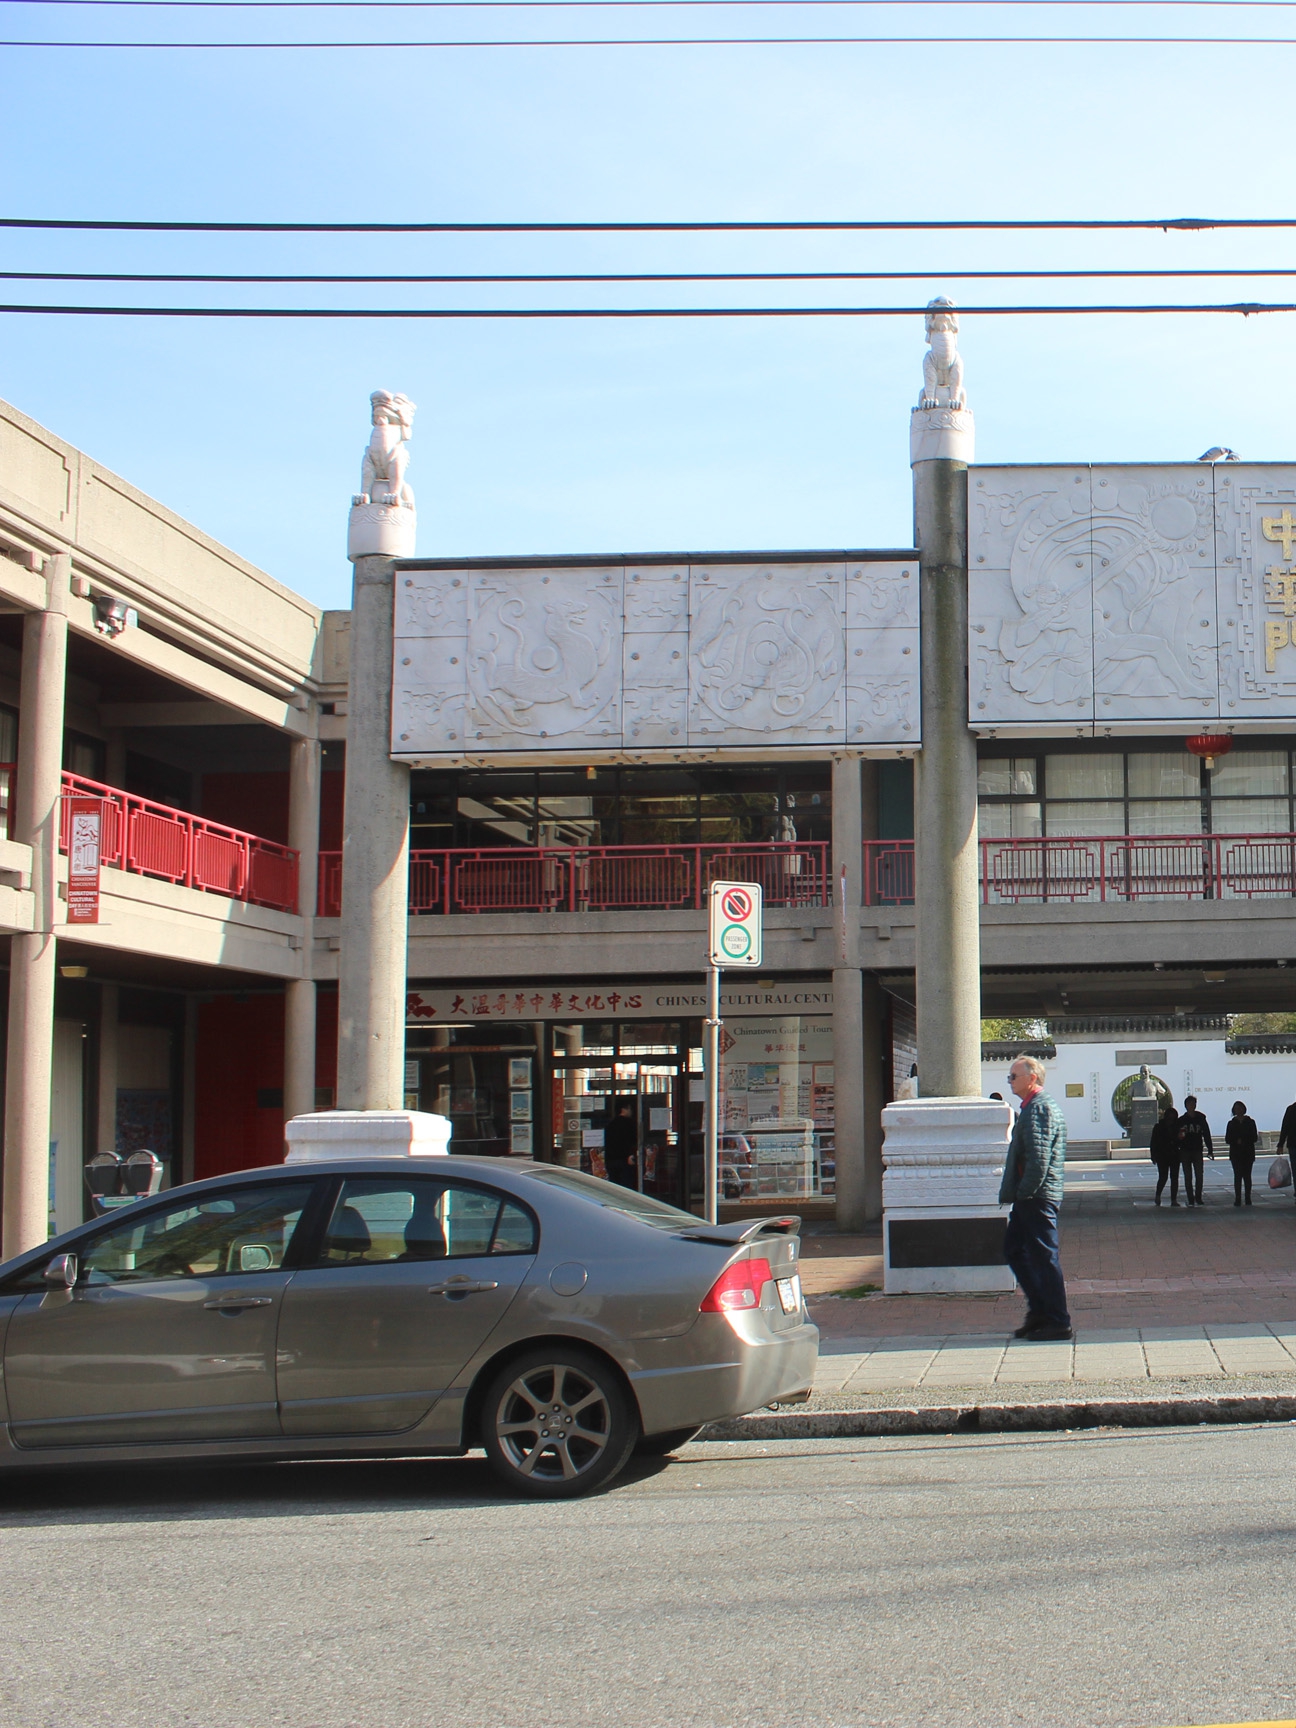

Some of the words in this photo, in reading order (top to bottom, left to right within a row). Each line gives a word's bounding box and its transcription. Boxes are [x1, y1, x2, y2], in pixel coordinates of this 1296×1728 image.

[725, 935, 748, 943] PASSENGER
[656, 995, 707, 1007] CHINES
[719, 993, 791, 1005] CULTURAL
[794, 993, 833, 1004] CENT
[733, 1026, 777, 1036] Chinatown
[780, 1025, 809, 1035] Guided
